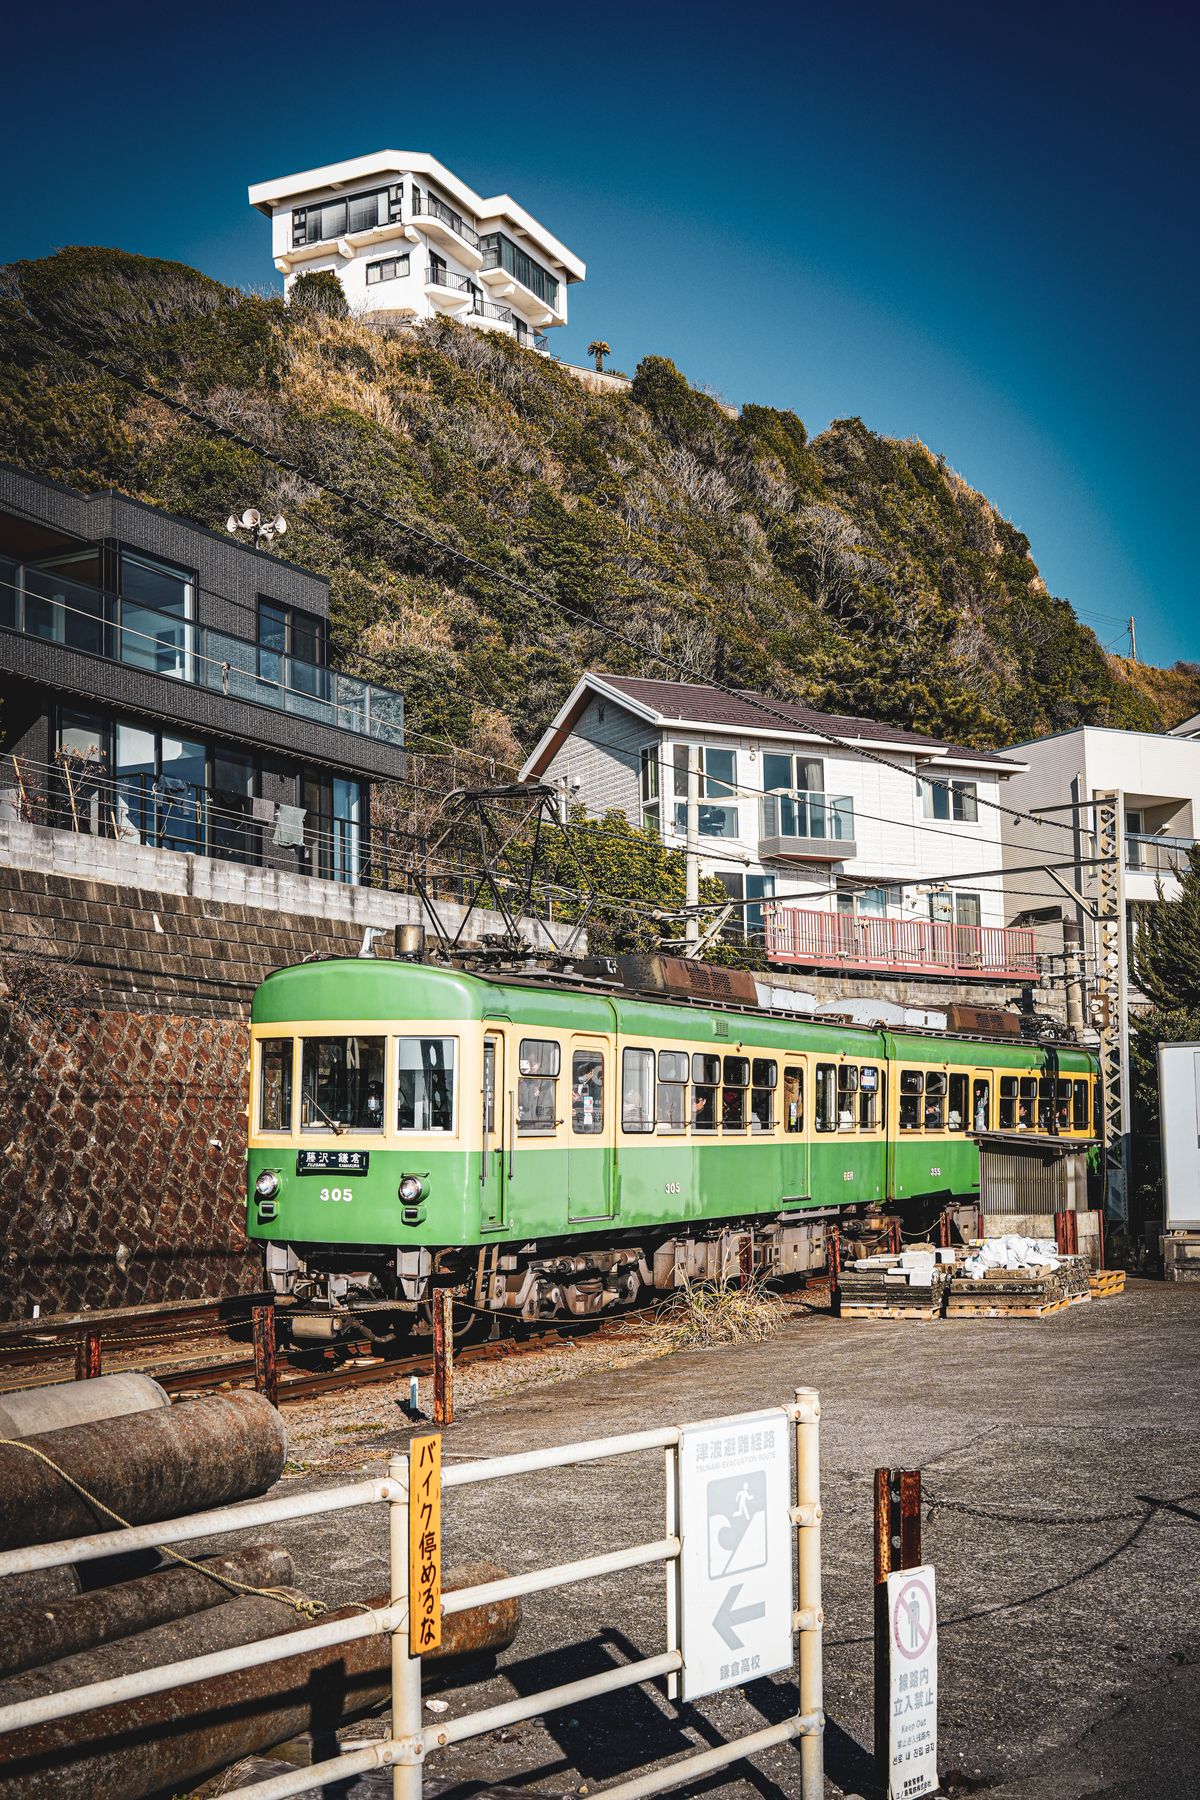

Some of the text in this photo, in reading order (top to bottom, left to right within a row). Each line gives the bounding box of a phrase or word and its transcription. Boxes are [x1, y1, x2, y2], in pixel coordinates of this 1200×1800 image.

[843, 1171, 854, 1181] EER
[930, 1167, 941, 1177] 355
[319, 1188, 353, 1202] 305
[665, 1182, 680, 1194] 305
[695, 1430, 775, 1462] 津波避難経路
[722, 1456, 757, 1468] EVACUATION
[758, 1451, 777, 1461] ROUTE
[418, 1440, 438, 1646] バイク停めるな
[719, 1654, 761, 1681] 鎌倉高校
[899, 1667, 929, 1693] 線路内
[893, 1687, 934, 1717] 立入禁止
[901, 1718, 927, 1734] Keep Out
